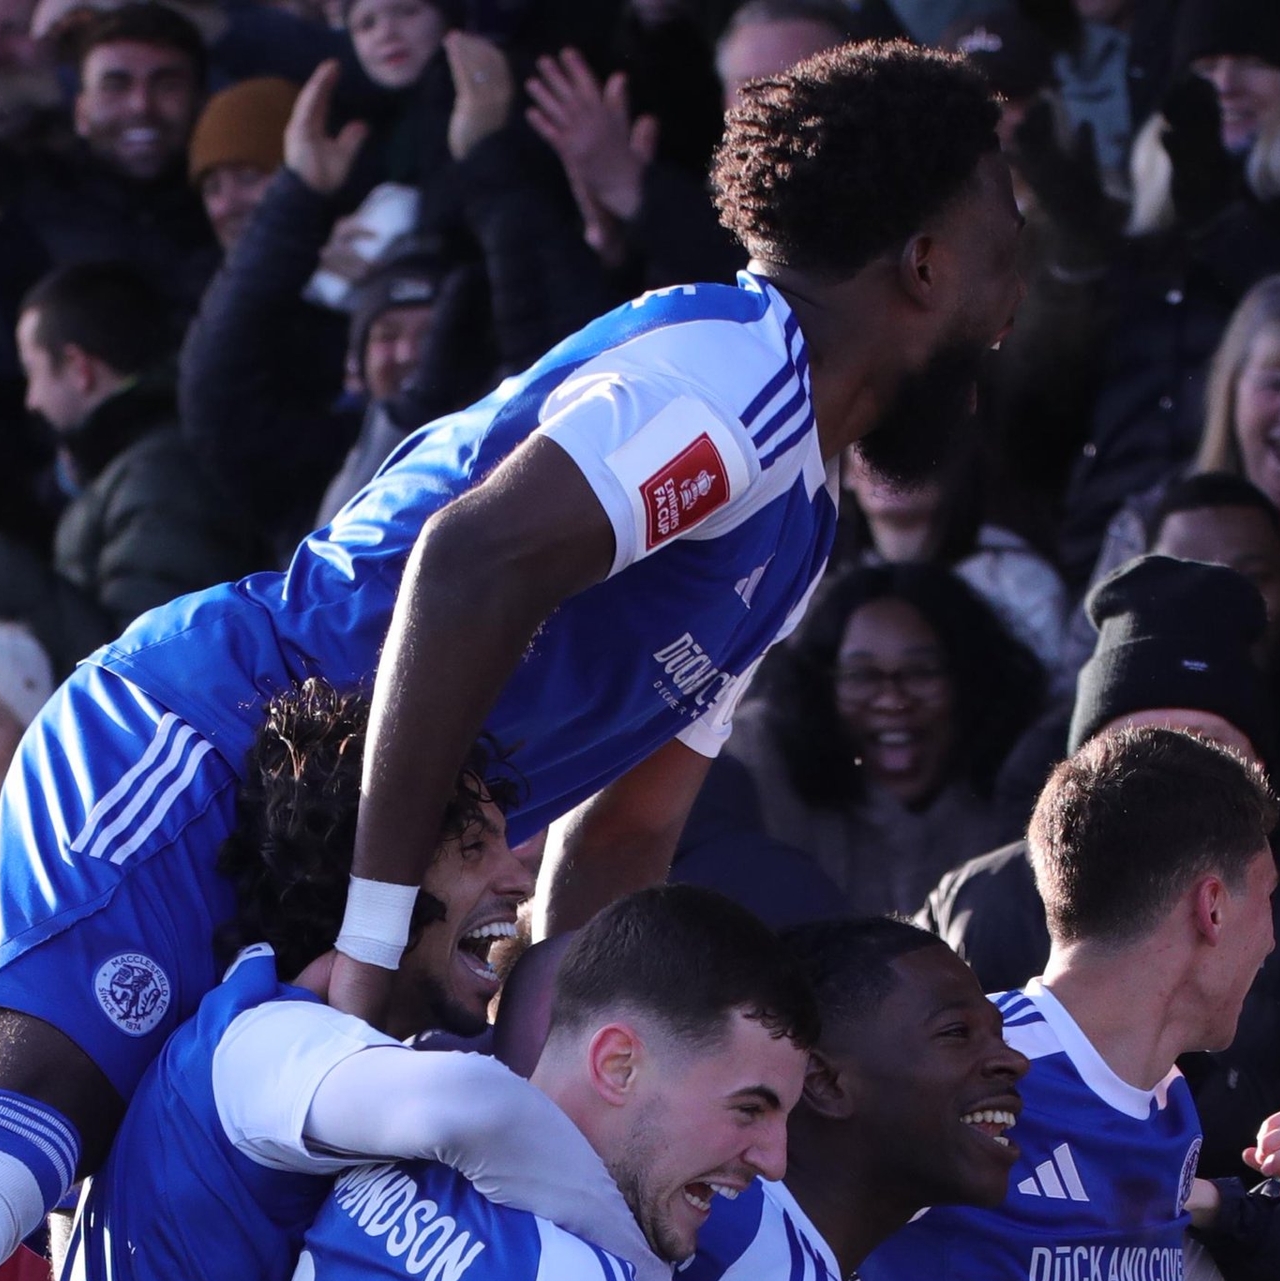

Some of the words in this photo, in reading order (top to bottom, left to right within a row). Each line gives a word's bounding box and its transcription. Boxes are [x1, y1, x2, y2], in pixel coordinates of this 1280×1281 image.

[653, 486, 666, 509] FA
[657, 507, 670, 535] CUP
[111, 955, 169, 997] MACCLESFIELD
[157, 1000, 167, 1014] FC
[98, 987, 117, 1015] SINCE
